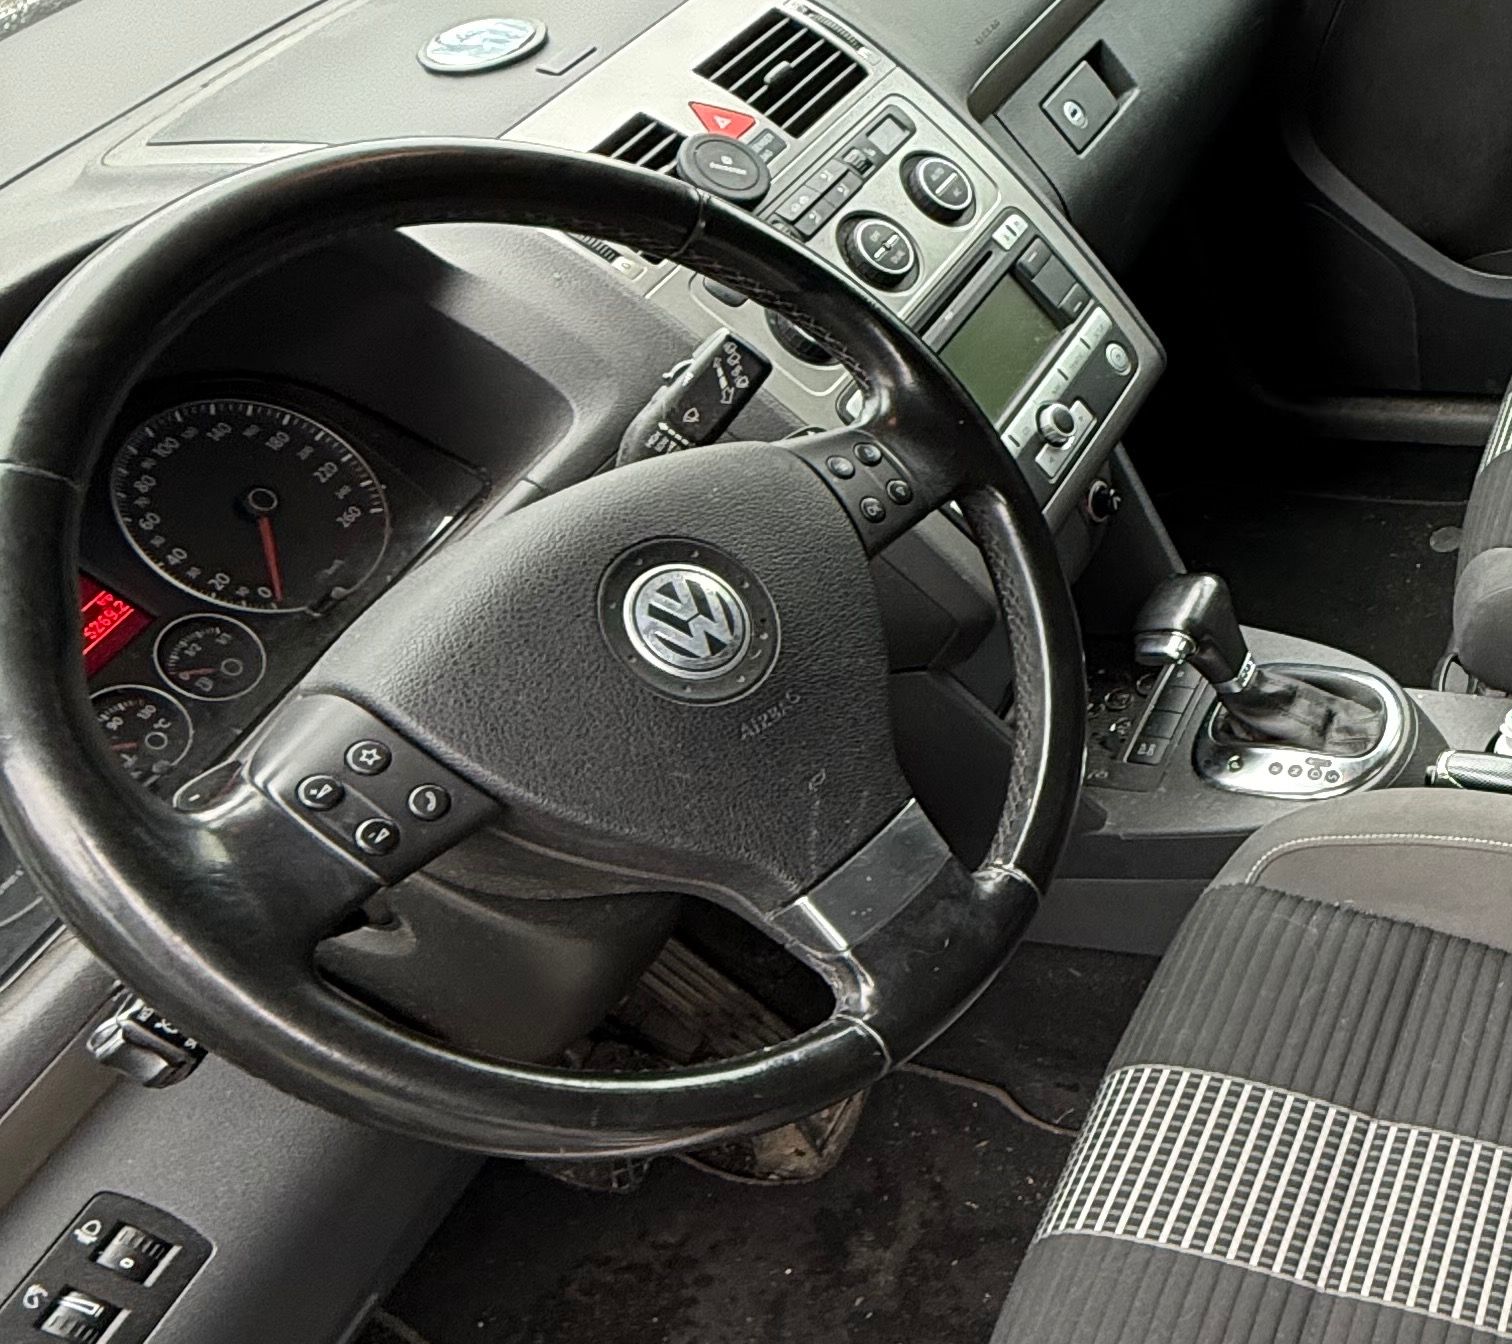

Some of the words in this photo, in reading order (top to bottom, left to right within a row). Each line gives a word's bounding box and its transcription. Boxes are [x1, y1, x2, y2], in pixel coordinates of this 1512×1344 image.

[139, 512, 161, 530] 60
[166, 547, 188, 565] 40
[208, 572, 230, 591] 20
[257, 586, 272, 598] 0
[634, 570, 744, 670] VW
